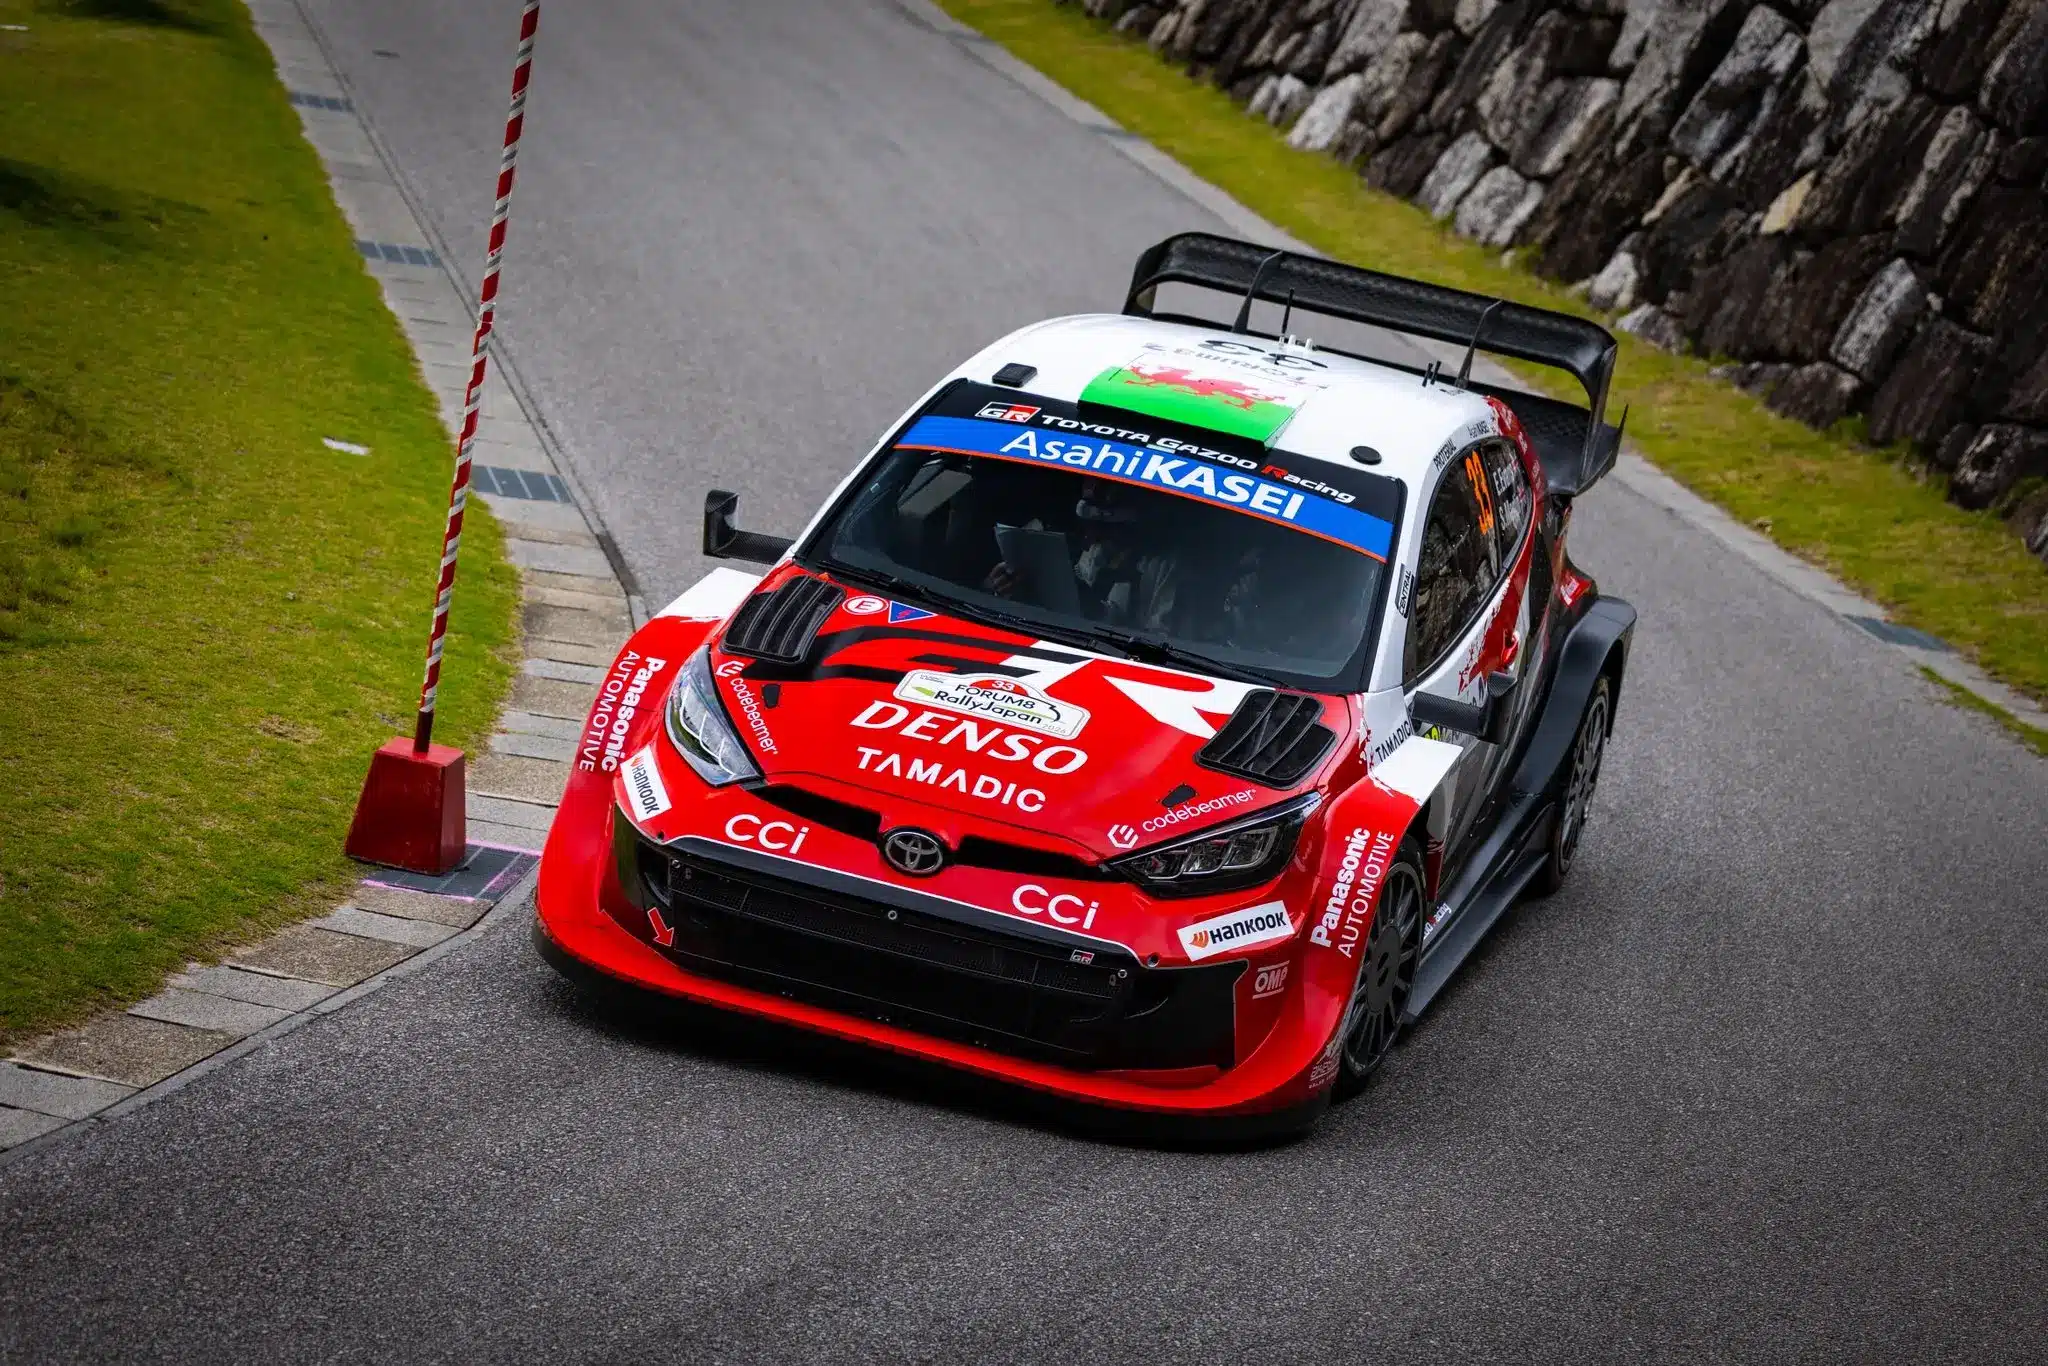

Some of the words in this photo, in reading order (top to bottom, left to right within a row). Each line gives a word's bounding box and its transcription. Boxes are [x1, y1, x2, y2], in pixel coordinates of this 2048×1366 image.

[977, 404, 1038, 423] GR
[1041, 415, 1150, 442] TOYOTA
[1149, 437, 1258, 470] GAZOO
[1261, 463, 1356, 504] Racing
[1000, 430, 1305, 521] AsahiKASEI
[855, 600, 876, 611] E
[579, 649, 637, 773] AUTOMOTIVE
[934, 690, 1042, 725] RallyJapan
[955, 683, 1036, 710] FORUM8
[991, 679, 1015, 692] 33
[601, 656, 667, 774] Panasonic
[729, 677, 779, 755] codebeamer
[850, 700, 1088, 775] DENSO
[1375, 718, 1412, 763] TAMADIC
[857, 746, 1047, 813] TAMADIC
[724, 813, 810, 854] CCi
[1142, 788, 1254, 832] codebeamer
[1012, 884, 1100, 930] CCi
[1309, 827, 1371, 948] Panasonic
[1337, 831, 1394, 959] AUTOMOTIVE
[1254, 968, 1288, 994] OMP
